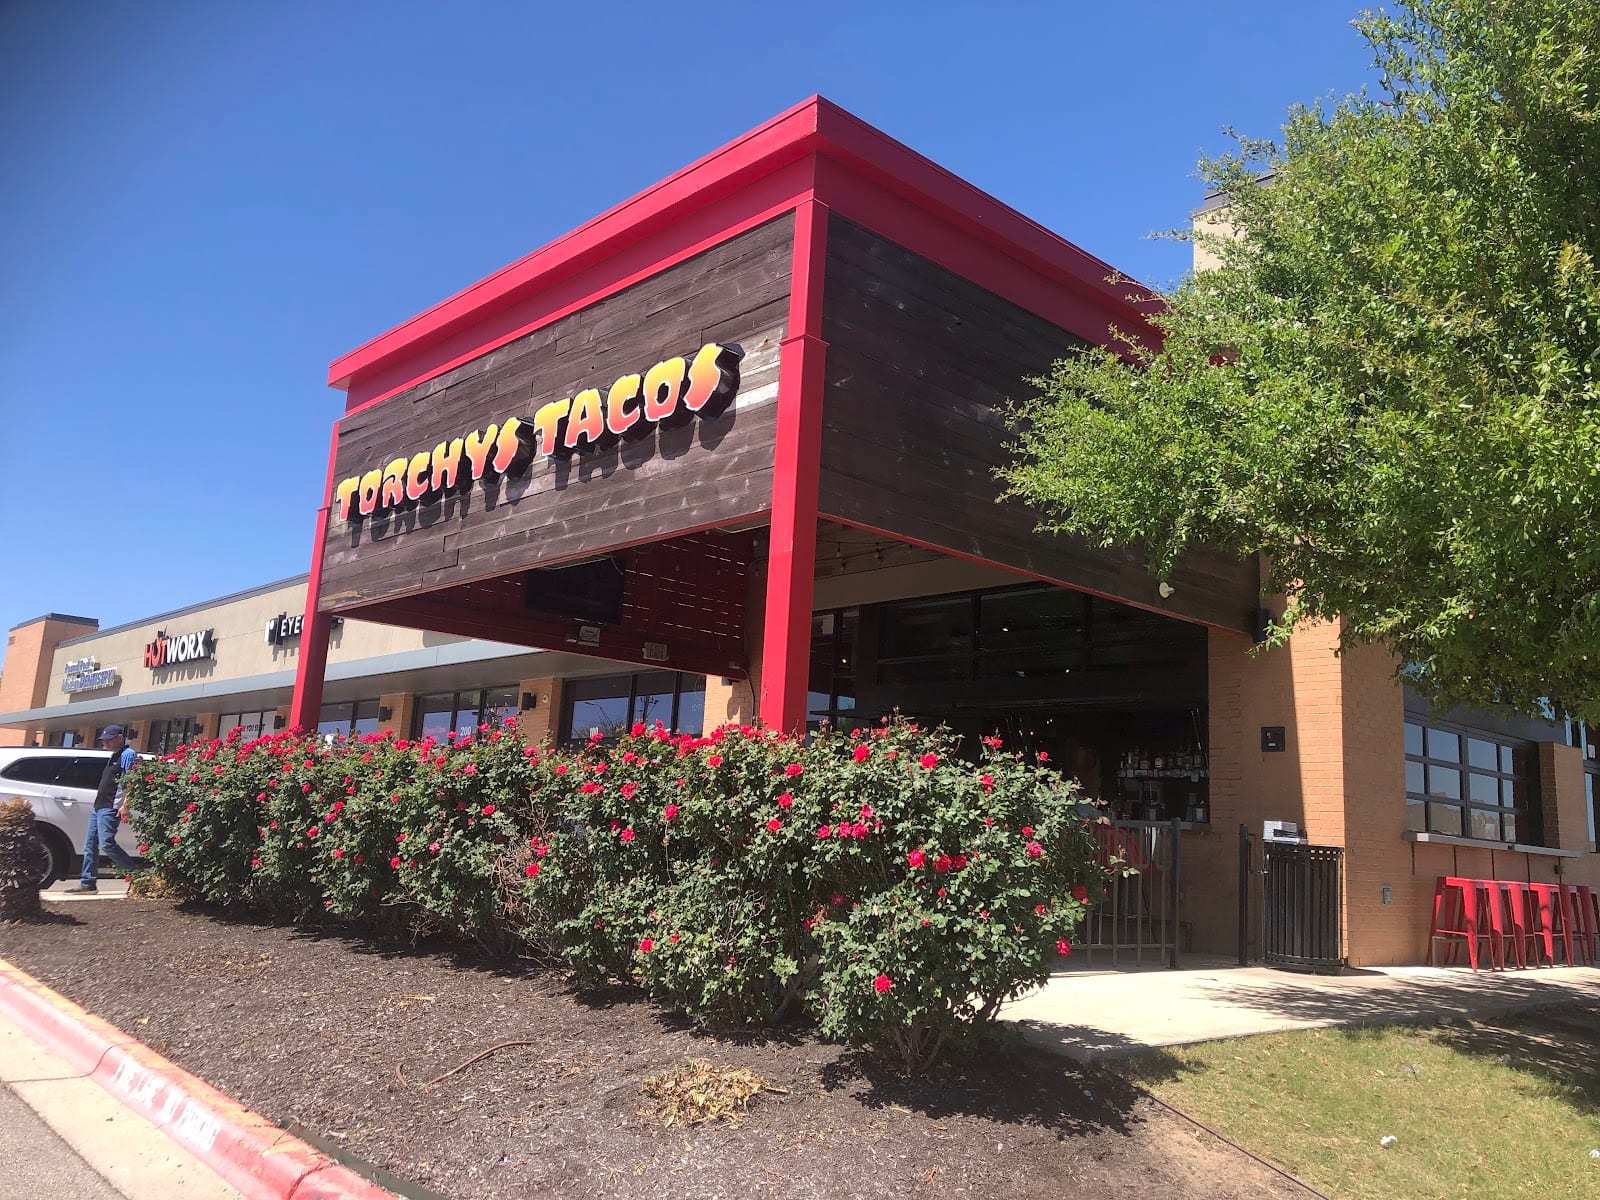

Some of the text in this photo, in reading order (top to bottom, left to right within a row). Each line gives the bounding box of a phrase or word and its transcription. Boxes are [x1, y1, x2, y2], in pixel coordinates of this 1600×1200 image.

[335, 342, 723, 521] TORCHYS TACOS
[143, 630, 206, 669] HOTWORX
[460, 726, 472, 736] 200
